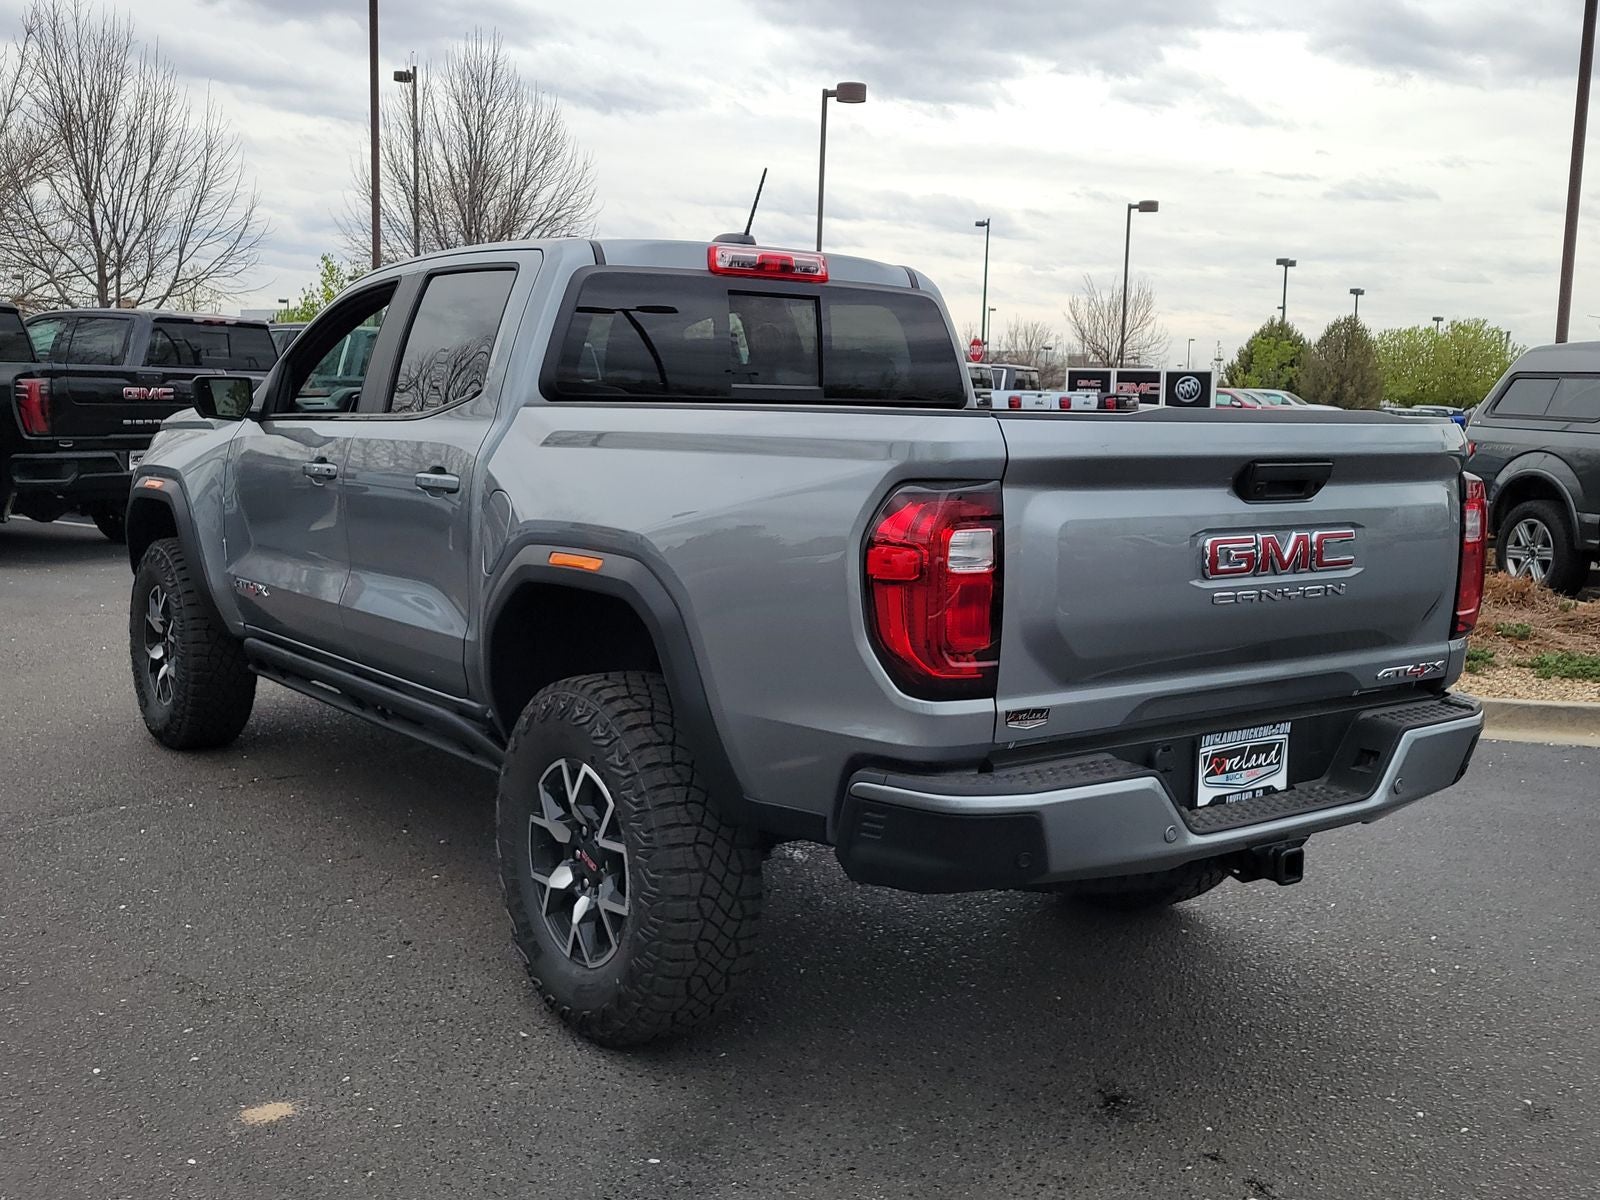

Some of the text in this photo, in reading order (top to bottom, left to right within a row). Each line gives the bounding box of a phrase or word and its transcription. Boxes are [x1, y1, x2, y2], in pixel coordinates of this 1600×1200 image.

[969, 345, 983, 355] STOP
[1076, 379, 1102, 387] GMC
[1117, 382, 1160, 394] GMC
[123, 387, 174, 400] GMC
[1203, 529, 1355, 579] GMC
[1212, 583, 1347, 605] CANYON
[1376, 660, 1445, 680] AT4X
[1225, 772, 1243, 782] BUICK
